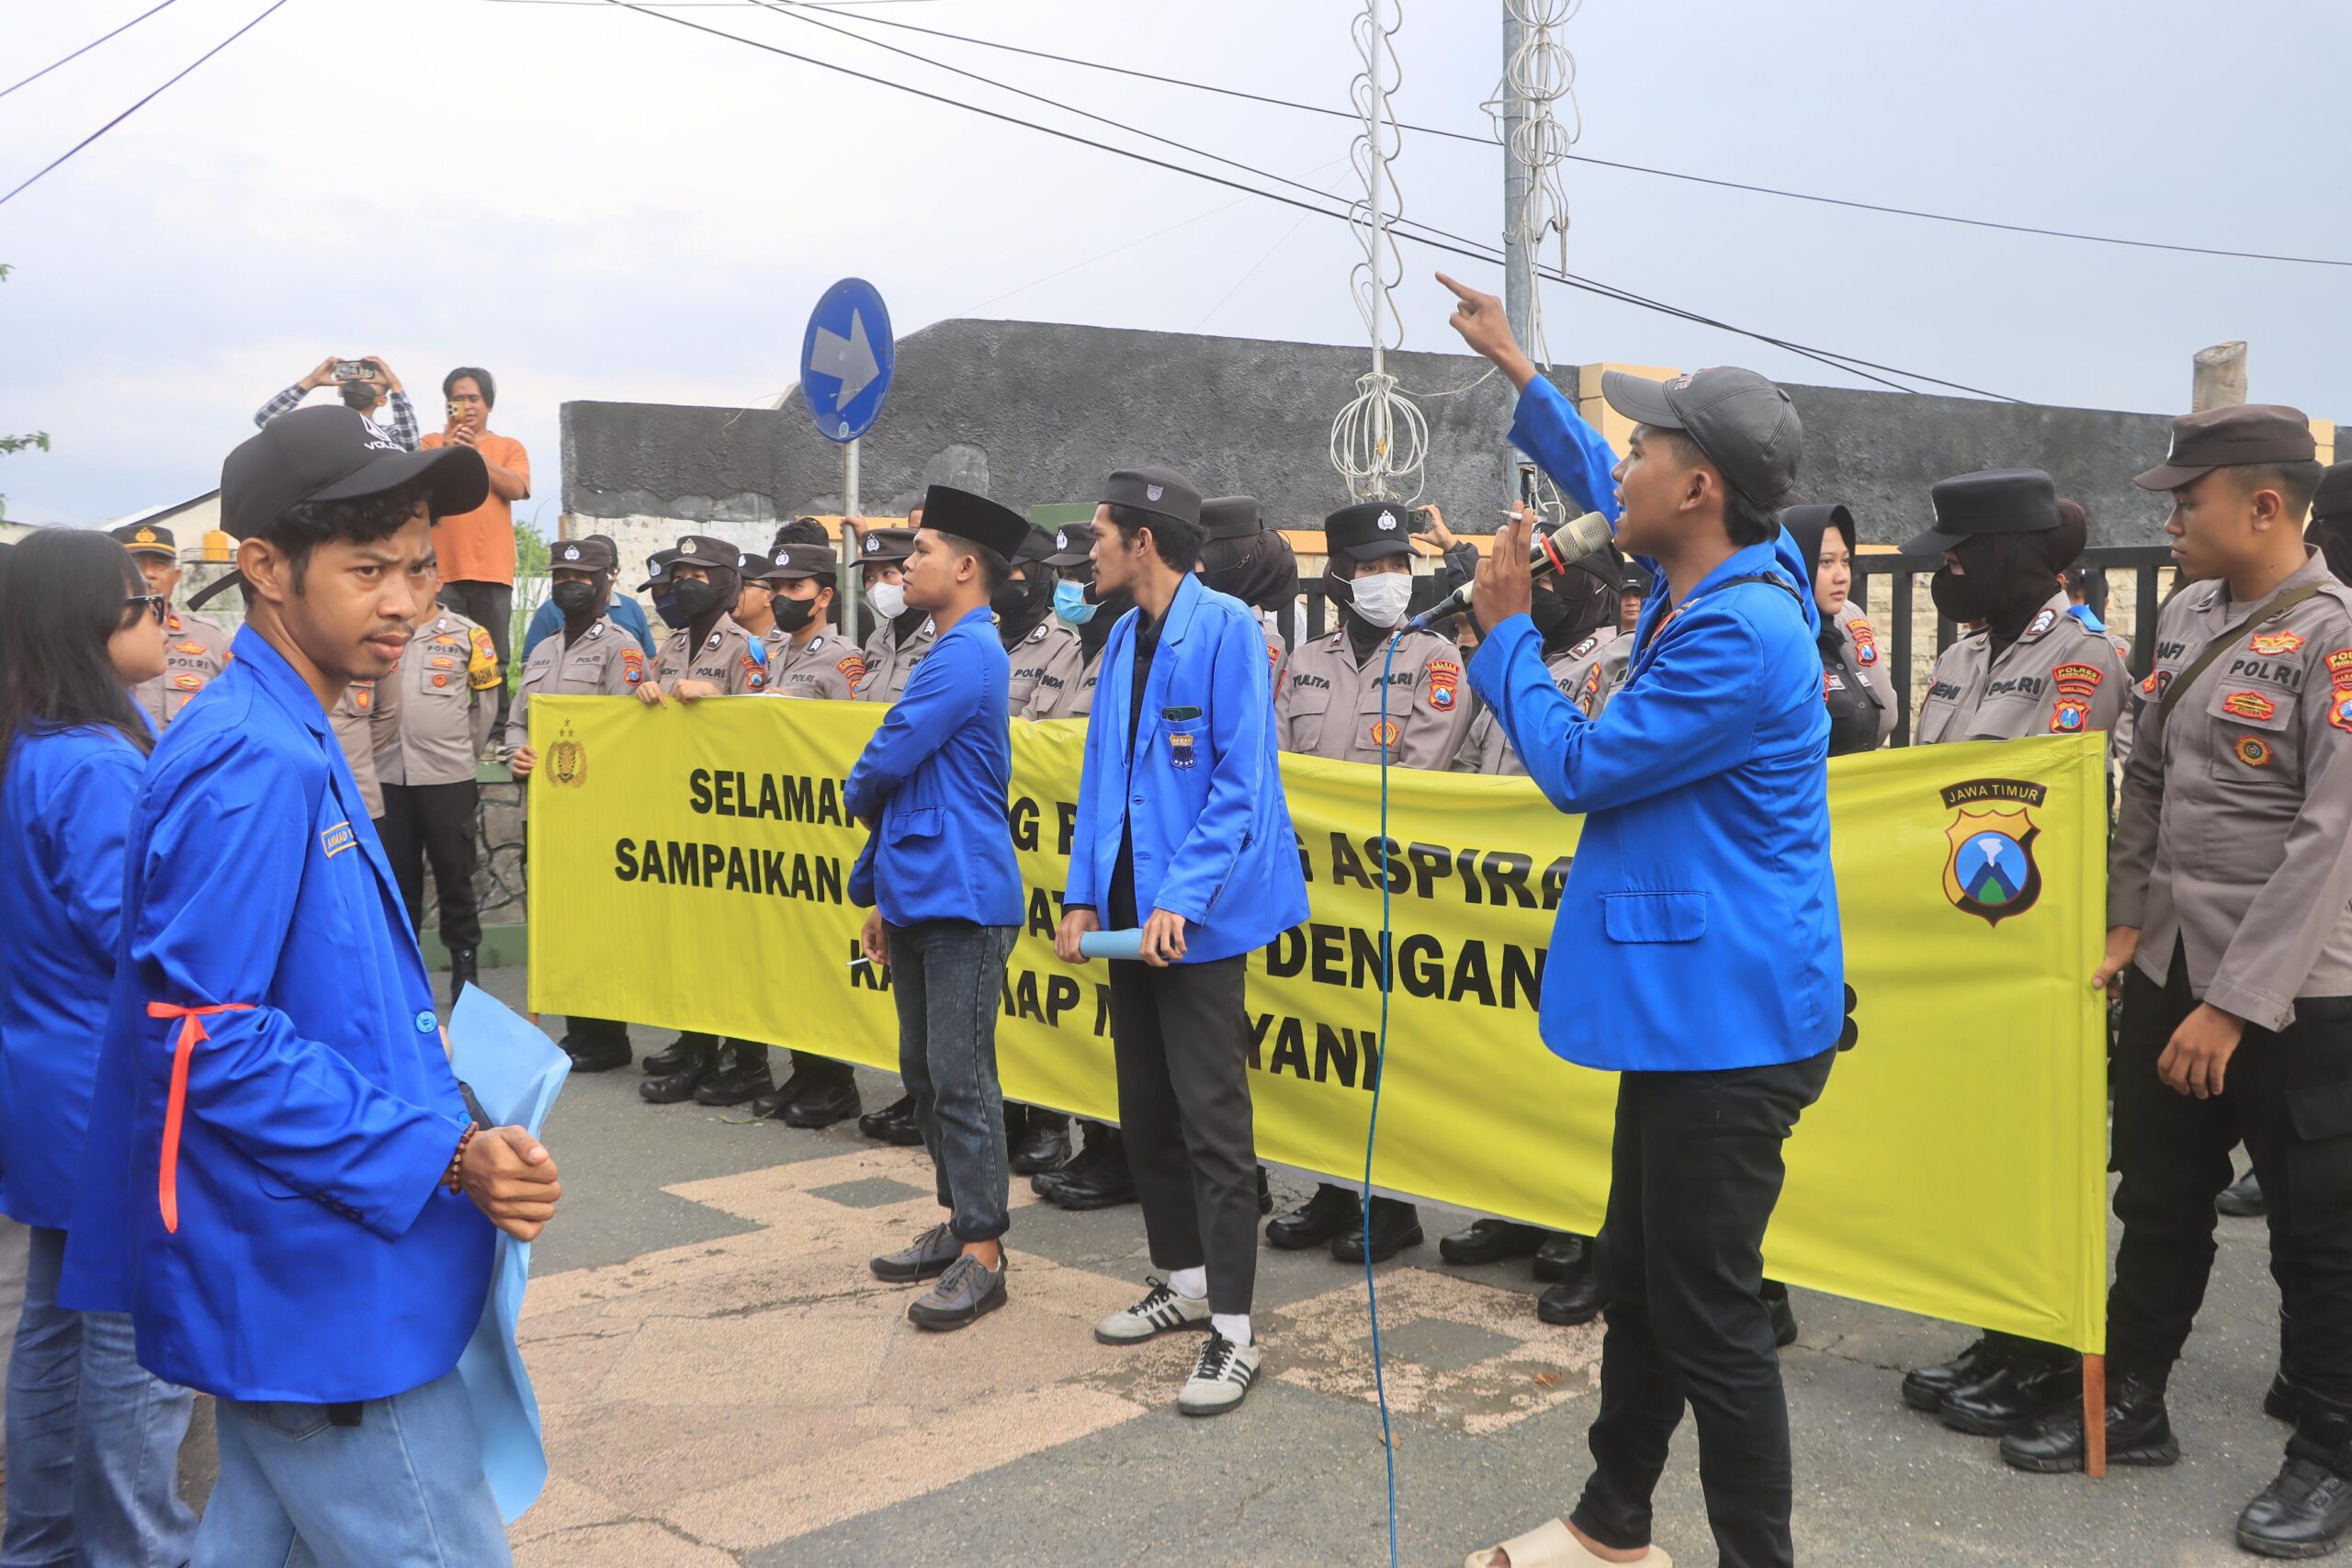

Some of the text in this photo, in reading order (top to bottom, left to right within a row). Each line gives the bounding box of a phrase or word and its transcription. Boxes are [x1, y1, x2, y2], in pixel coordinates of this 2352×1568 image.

[426, 645, 459, 654] POLRI
[168, 658, 209, 671] POLRI
[575, 655, 601, 664] POLRI
[695, 667, 726, 679] POLRI
[790, 674, 816, 683] POLRI
[1014, 668, 1045, 680] POLR
[2229, 660, 2301, 688] POLRI
[1293, 674, 1331, 690] YULITA
[1988, 676, 2041, 696] POLRI
[1950, 784, 2039, 803] JAWA TIMUR
[615, 838, 1548, 1013] SAMPAIKAN DENGAN
